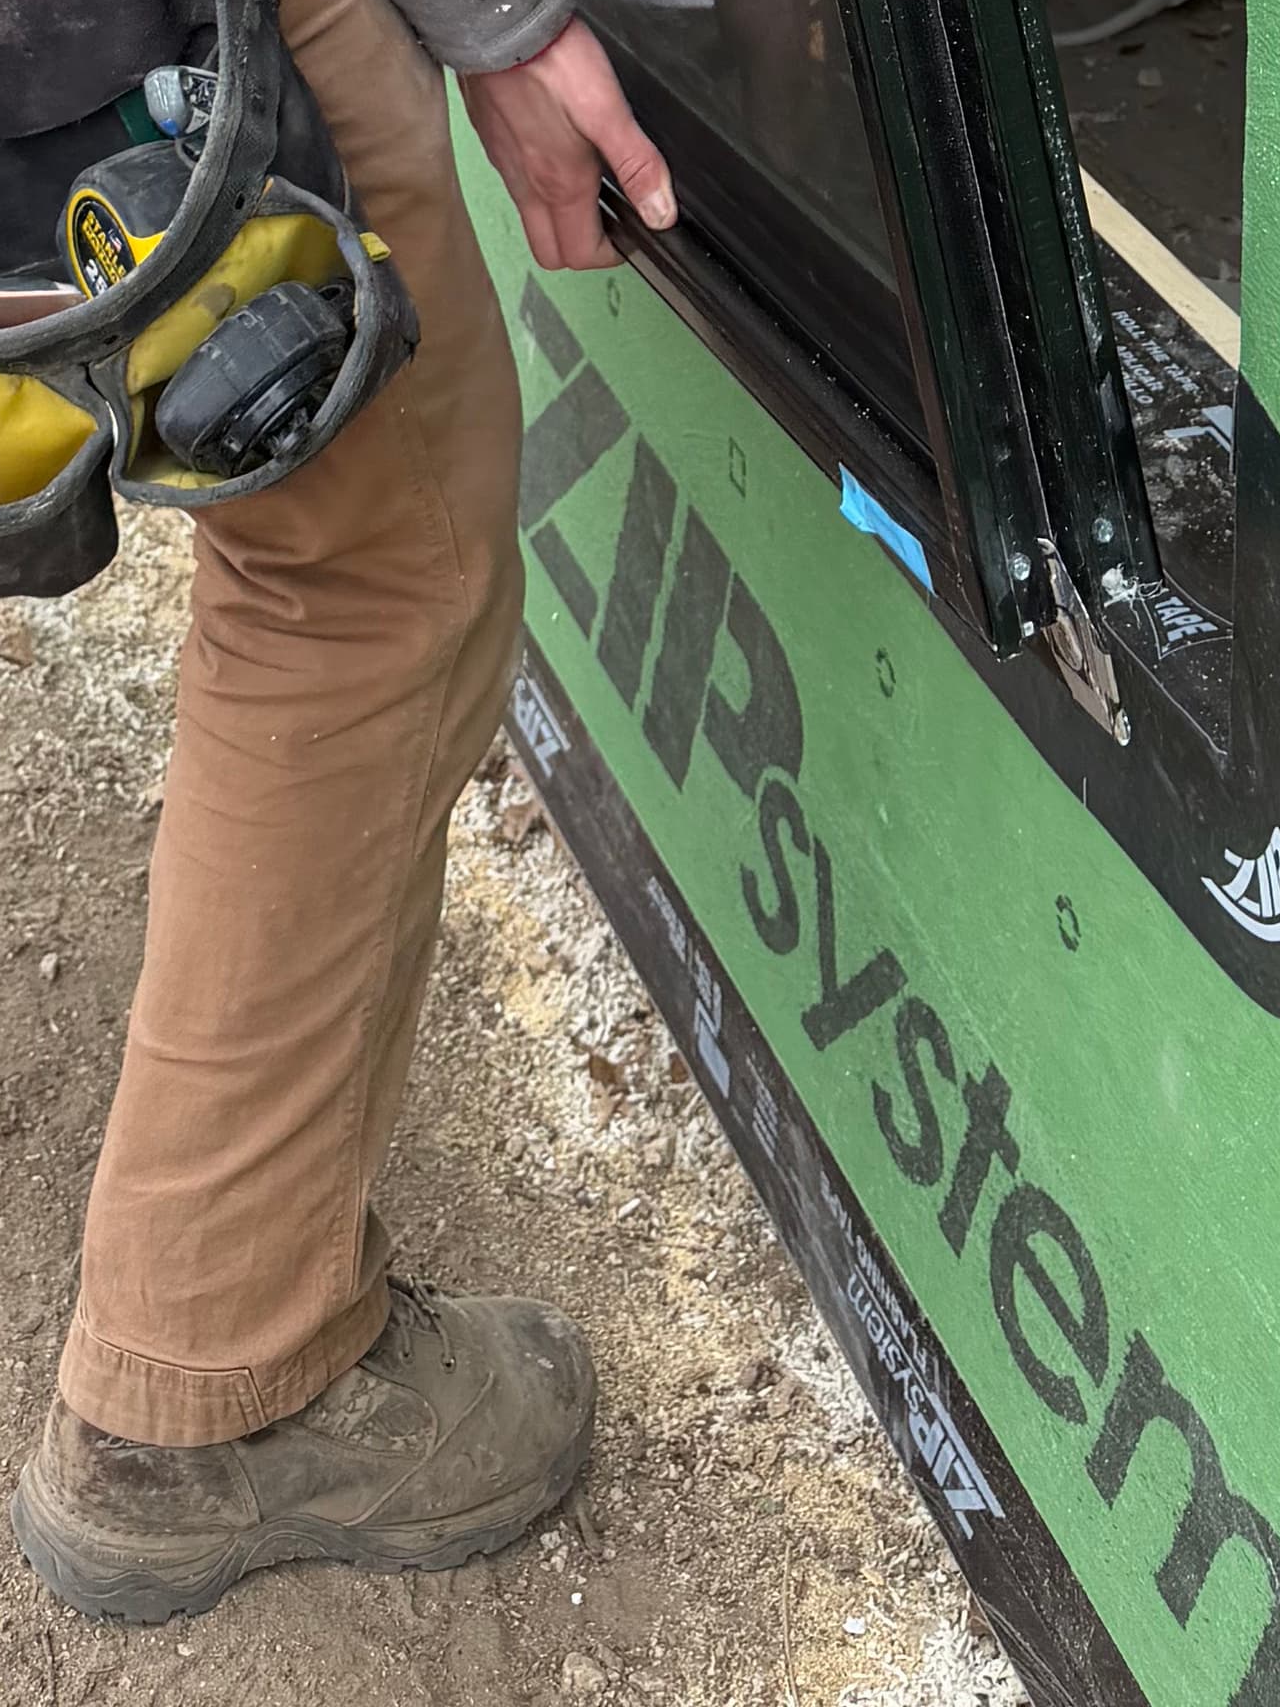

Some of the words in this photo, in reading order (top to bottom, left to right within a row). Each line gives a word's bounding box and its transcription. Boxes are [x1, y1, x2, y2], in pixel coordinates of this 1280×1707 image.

[86, 209, 127, 278] STANLE
[1111, 310, 1146, 340] ROLL
[1141, 338, 1171, 364] THE
[1163, 362, 1200, 392] TAPE
[1154, 595, 1219, 643] TAPE
[847, 1272, 928, 1417] system
[909, 1412, 988, 1541] ZIP
